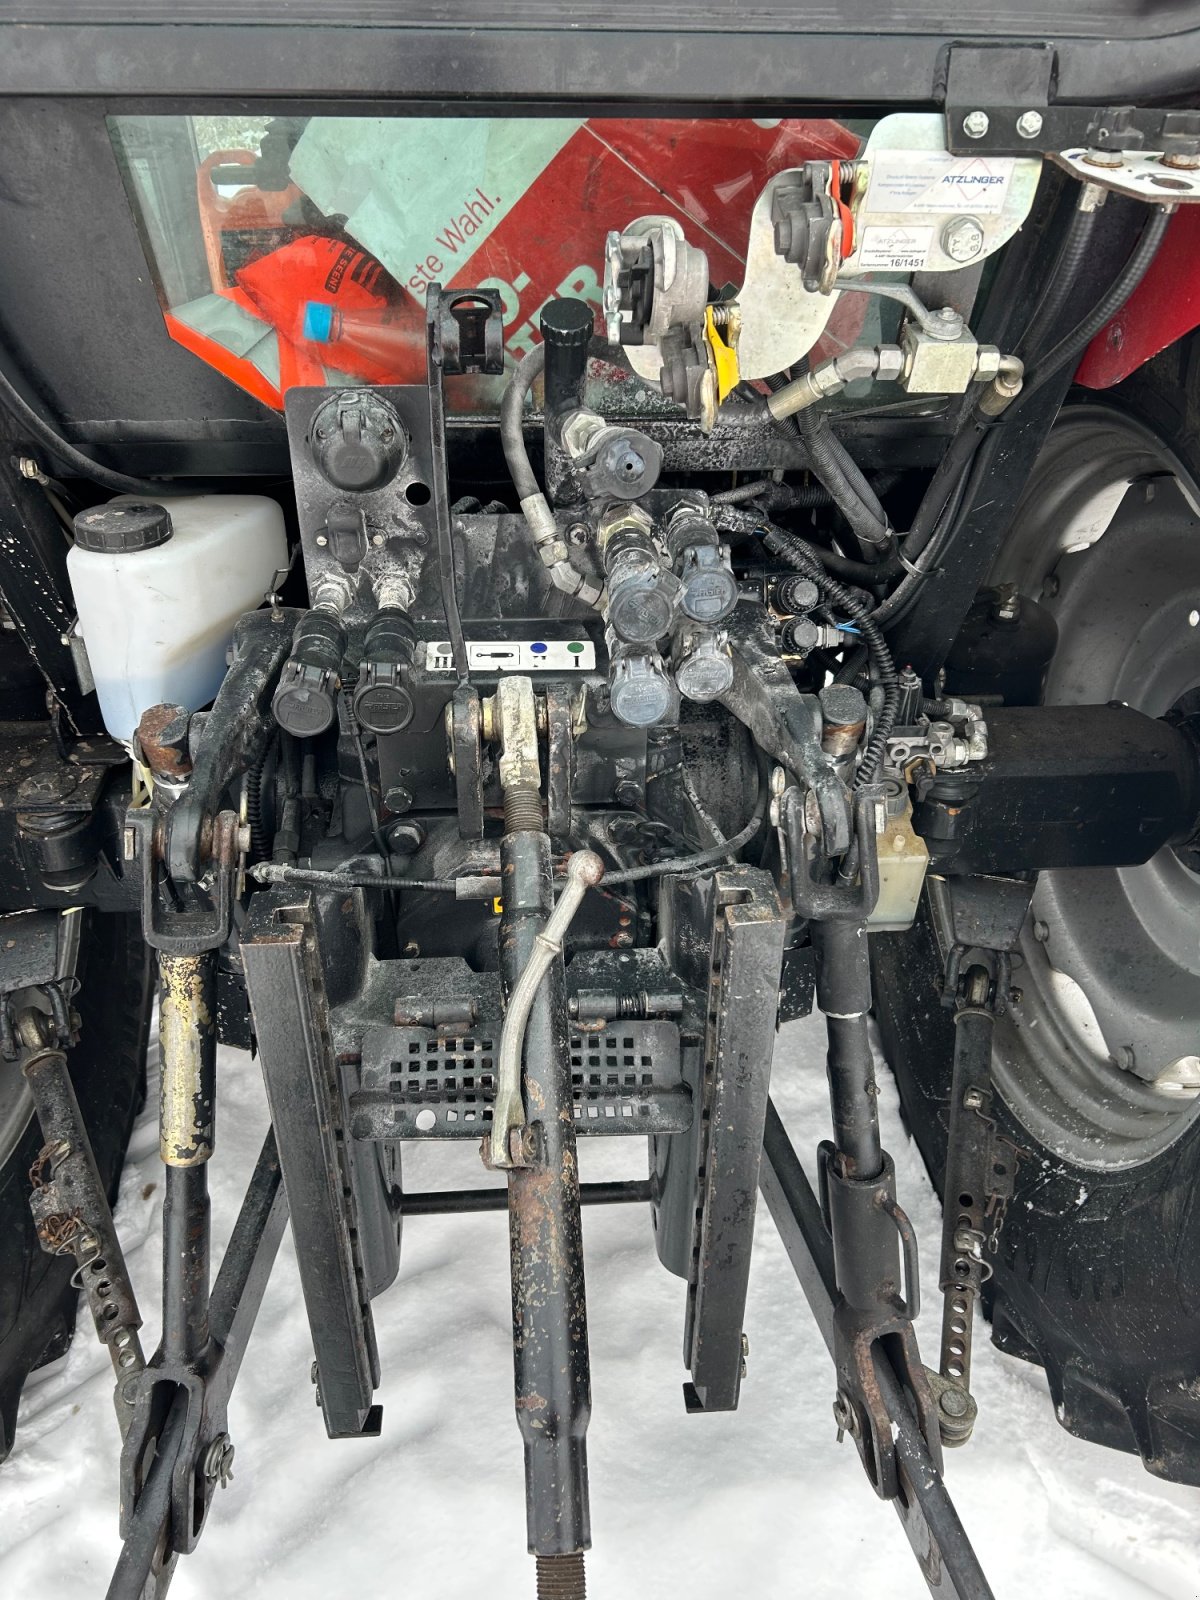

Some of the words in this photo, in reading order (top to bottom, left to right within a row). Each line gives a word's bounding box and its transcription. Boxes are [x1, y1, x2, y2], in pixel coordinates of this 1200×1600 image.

[942, 175, 1004, 184] ATZLINGER
[405, 254, 444, 295] ste
[435, 187, 502, 254] Wahl.
[890, 258, 925, 267] 16/1451
